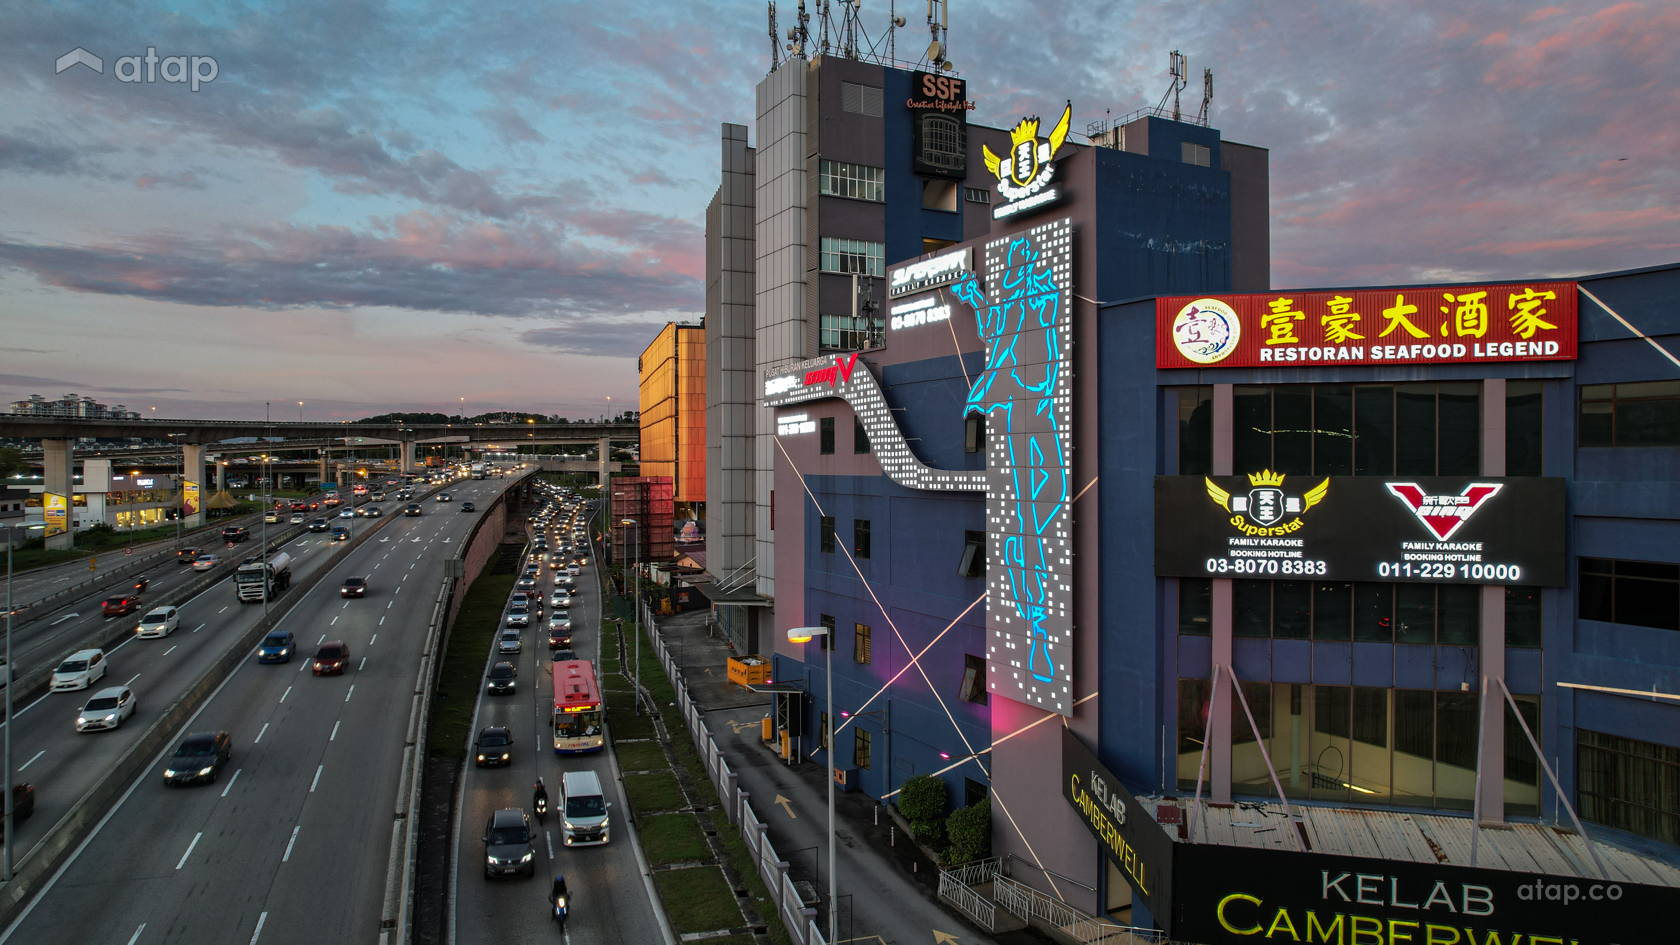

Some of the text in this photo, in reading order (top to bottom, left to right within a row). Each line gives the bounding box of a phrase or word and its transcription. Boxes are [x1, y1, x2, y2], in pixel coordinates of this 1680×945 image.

[922, 74, 961, 101] SSF
[1260, 287, 1559, 346] 壹豪大酒家
[1260, 340, 1559, 362] RESTORAN SEAFOOD LEGEND
[1229, 514, 1305, 537] Superstar
[1229, 538, 1304, 547] FAMILY KARAOKE
[1230, 549, 1303, 558] BOOKING HOTLINE
[1402, 542, 1483, 551] FAMILY KARAOKE
[1206, 558, 1327, 575] 03-8070 8383
[1404, 553, 1482, 562] BOOKING HOTLINE
[1378, 562, 1521, 580] 011-229 10000
[1090, 770, 1126, 825] KELAB
[1071, 773, 1150, 896] CAMBERWELL
[1321, 870, 1496, 917] KELAB
[1216, 893, 1584, 945] CAMBERW
